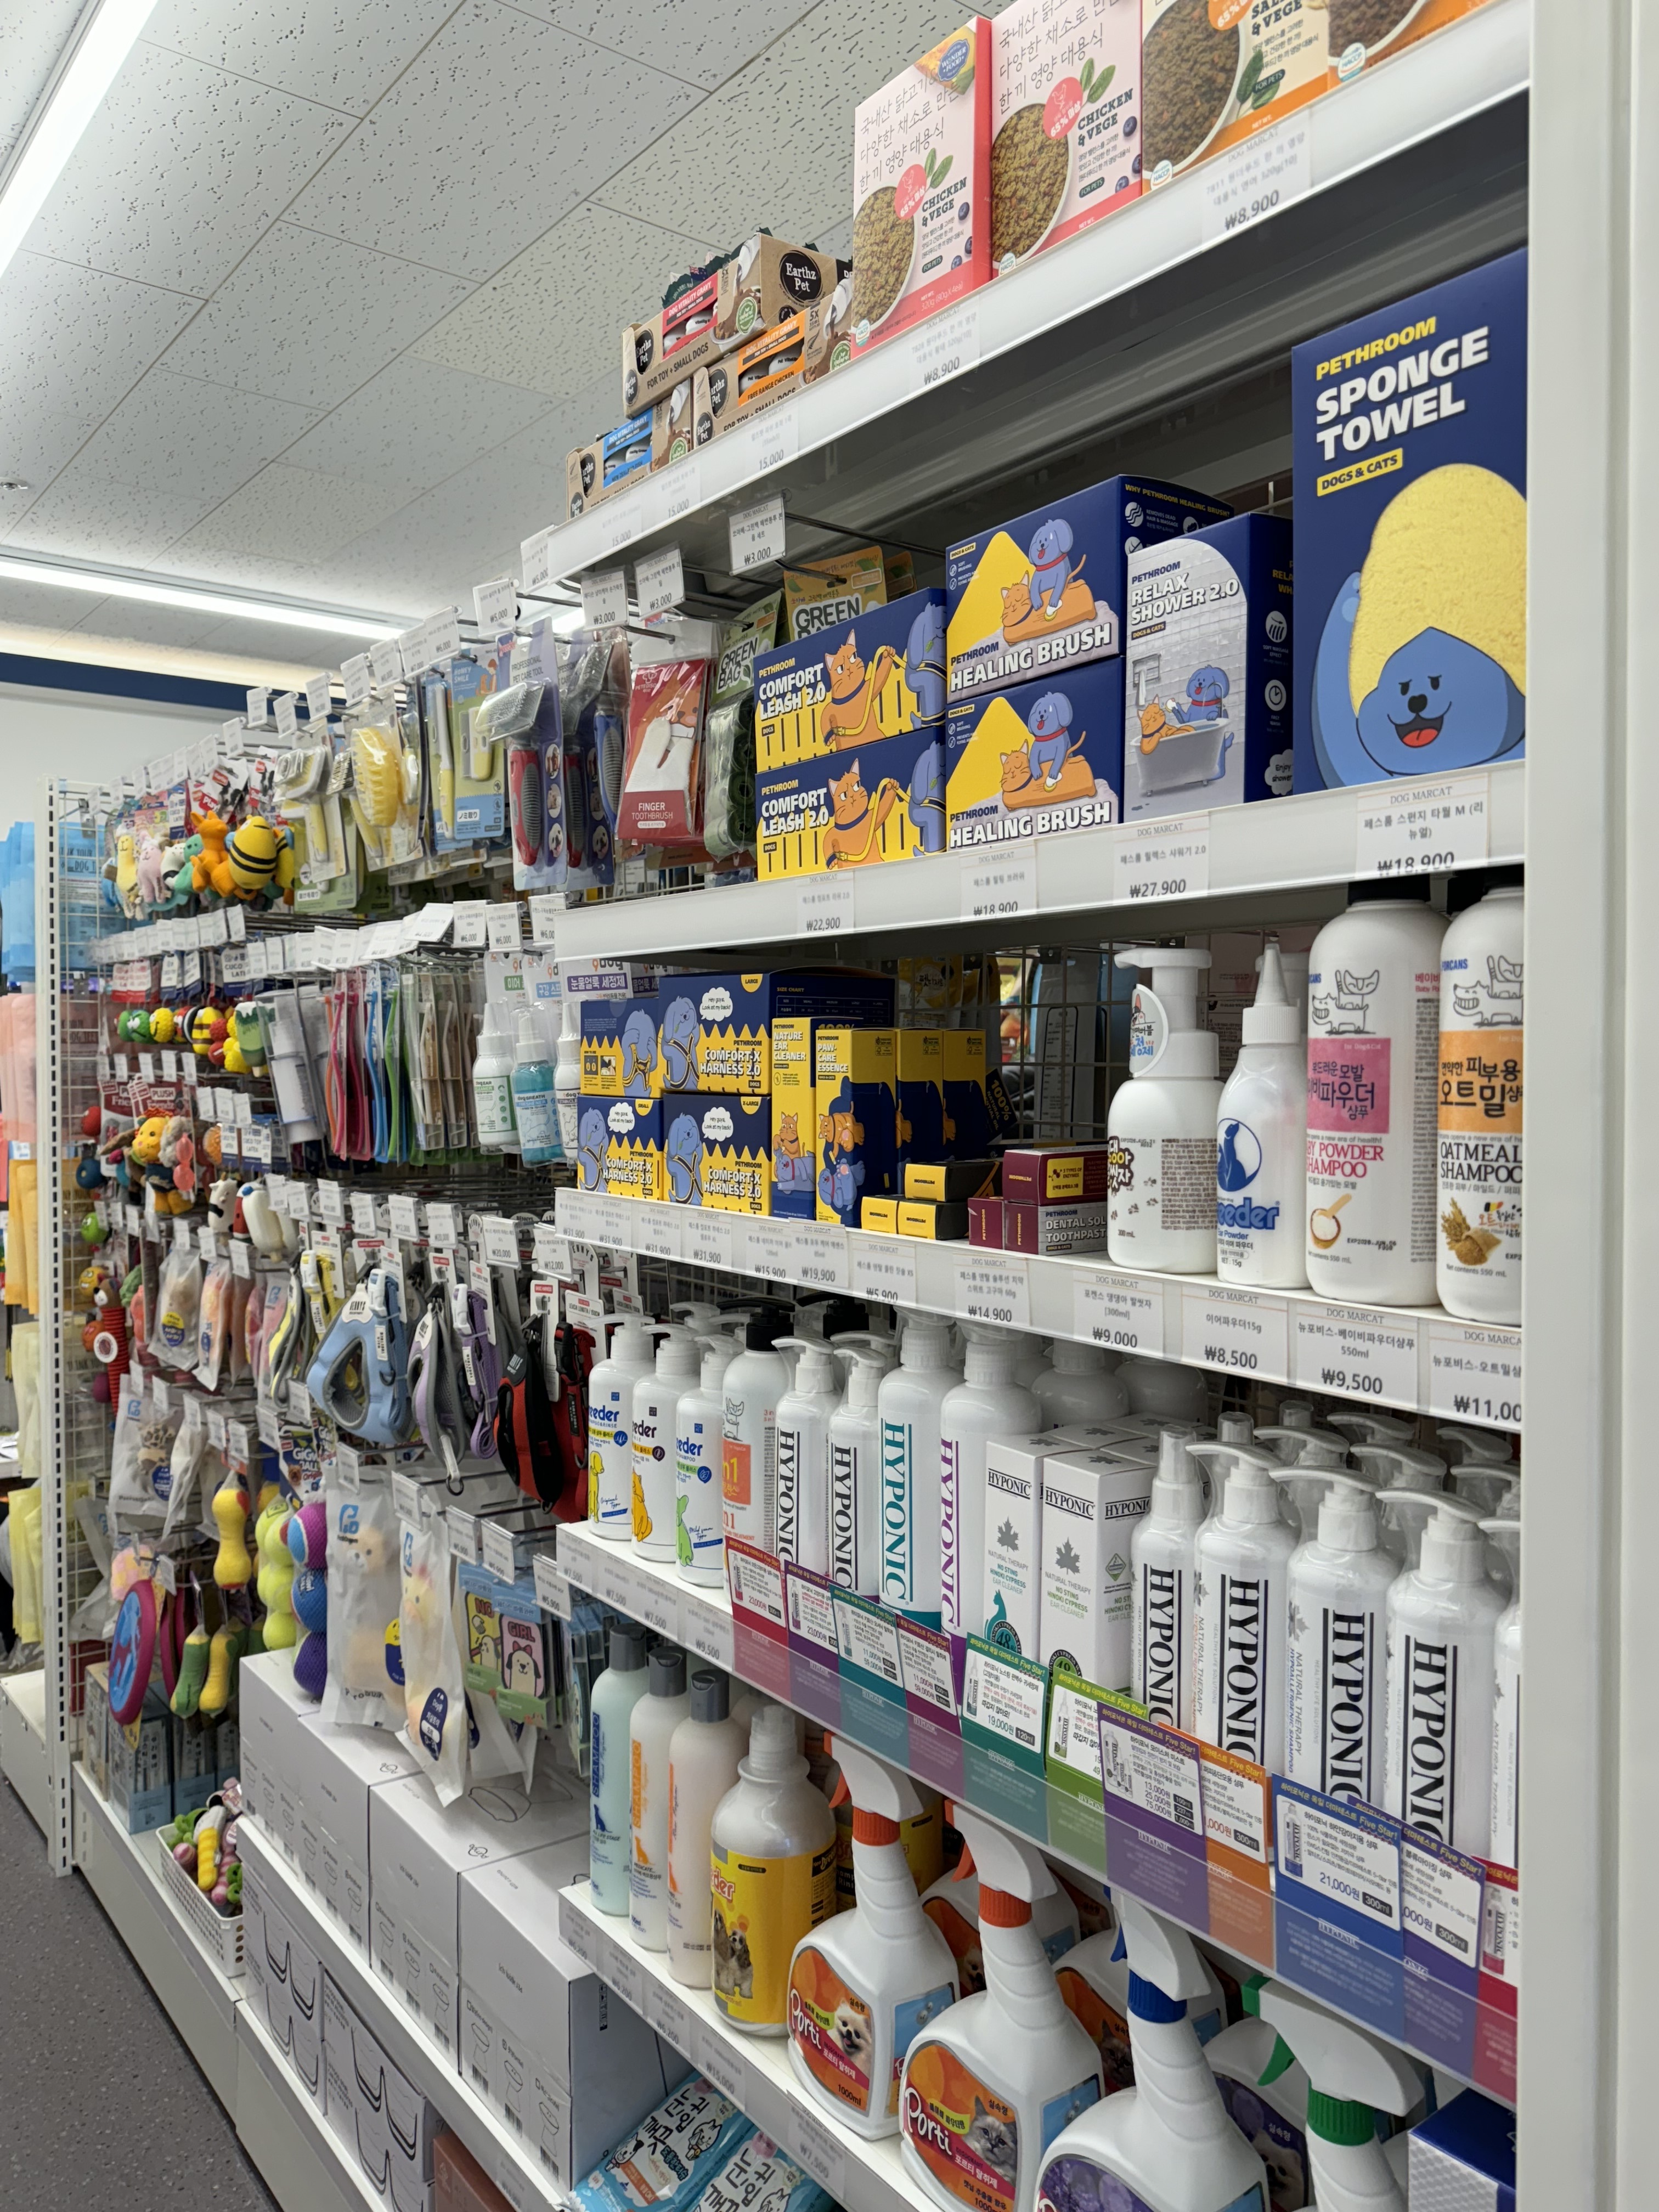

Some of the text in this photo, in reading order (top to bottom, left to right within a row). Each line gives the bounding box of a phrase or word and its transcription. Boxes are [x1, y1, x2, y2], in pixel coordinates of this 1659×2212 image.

[1000, 8, 1038, 48] 국내산
[1251, 0, 1302, 36] & VEGE
[1000, 6, 1088, 81] 다양한 채소로
[1000, 22, 1103, 115] 한 끼 영양 대용식
[1255, 72, 1283, 91] FOR PETS
[1077, 88, 1133, 131] CHICKEN
[1078, 113, 1118, 147] & VEGE
[885, 117, 944, 173] 영양 대용식
[922, 177, 967, 212] CHICKEN
[1081, 179, 1103, 196] FOR PETS
[922, 198, 955, 228] & VEGE
[1225, 189, 1279, 230] ₩8,900
[786, 265, 816, 280] Earthz
[923, 256, 941, 272] FOR PETS
[794, 279, 810, 292] Pet
[1317, 316, 1436, 381] PETHROOM
[923, 357, 960, 383] ₩8,900
[1317, 326, 1488, 425] SPONGE
[1317, 382, 1465, 461] TOWEL
[1322, 455, 1398, 490] DOGS & CATS
[744, 546, 771, 565] ₩3,000
[1131, 561, 1181, 584] PETHROOM
[1131, 572, 1189, 607] RELAX
[1131, 579, 1239, 626] SHOWER 2.0
[593, 612, 616, 625] ₩3,000
[795, 597, 862, 630] GREEN
[511, 654, 542, 673] PROFESSIONAL
[720, 636, 758, 675] GREEN
[950, 642, 999, 667] PETHROOM
[950, 623, 1111, 693] HEALING BRUSH
[513, 666, 544, 684] PET CARE TOOL
[758, 657, 795, 679] PETHROOM
[759, 663, 824, 701] COMFORT
[760, 681, 826, 721] LEASH 2.0
[761, 779, 799, 796] PETHROOM
[1272, 775, 1293, 783] shower
[761, 788, 827, 819] COMFORT
[1390, 786, 1453, 805] DOG MARCAT
[458, 811, 478, 820] ノミ取り
[631, 810, 673, 821] TOOTHBRUSH
[638, 802, 665, 811] FINGER
[950, 804, 998, 822] PETHROOM
[762, 807, 830, 838] LEASH 2.0
[949, 801, 1111, 849] HEALING BRUSH
[1137, 822, 1183, 837] DOG MARCAT
[1128, 878, 1187, 899] ₩27,900
[973, 900, 1018, 918] ₩18,900
[571, 975, 625, 990] 눈물얼룩 세정제
[774, 1031, 803, 1041] NATURE
[774, 1042, 788, 1051] EAR
[705, 1050, 761, 1063] COMFORT-X
[774, 1052, 806, 1061] CLEANER
[817, 1053, 837, 1063] CARE
[700, 1063, 761, 1076] HARNESS 2.0
[817, 1064, 849, 1073] ESSENCE
[1466, 1056, 1520, 1084] 피부용
[990, 1079, 1010, 1121] 100%
[1347, 1104, 1369, 1120] 샴푸
[1319, 1143, 1384, 1161] POWDER
[1440, 1141, 1522, 1163] OATMEAL
[607, 1157, 653, 1172] COMFORT-X
[603, 1170, 652, 1184] HARNESS 2.0
[708, 1168, 761, 1184] COMFORT-X
[704, 1181, 761, 1199] HARNESS 2.0
[1045, 1210, 1078, 1218] PETHROOM
[693, 1249, 721, 1264] ₩31,900
[972, 1258, 1006, 1268] DOG MARCAT
[802, 1267, 836, 1283] ₩19,900
[1096, 1275, 1138, 1289] DOG MARCAT
[1209, 1290, 1259, 1305] DOG MARCAT
[968, 1304, 1012, 1323] ₩14,900
[1206, 1313, 1262, 1334] 이어파우더15g
[1327, 1308, 1385, 1324] DOG MARCAT
[1092, 1327, 1138, 1348] ₩9,000
[1298, 1321, 1415, 1351] 뉴포비스-베이비파우더샴푸
[1205, 1345, 1257, 1369] ₩8,500
[1341, 1345, 1369, 1359] 550ml
[1321, 1368, 1383, 1395] ₩9,500
[988, 1471, 1031, 1497] HYPONIC
[884, 1419, 907, 1604] HYPONIC
[1045, 1489, 1094, 1517] HYPONIC
[833, 1446, 853, 1590] HYPONIC
[988, 1549, 1029, 1571] NATURAL THERAPY
[990, 1568, 1026, 1588] HINOKI CYPRESS
[1004, 1566, 1018, 1577] STING
[1045, 1571, 1091, 1595] NATURAL THERAPY
[1047, 1591, 1088, 1613] HINOKI CYPRESS
[1065, 1589, 1079, 1601] STING
[508, 1621, 536, 1643] GIRL
[591, 1713, 600, 1795] SHAMPOO
[632, 1741, 641, 1827] SHAMPOO
[1145, 1791, 1172, 1808] 25,000원
[1146, 1801, 1172, 1818] 75,000원
[1319, 1871, 1360, 1901] 21,000원
[1438, 1927, 1466, 1951] 300ml
[789, 1988, 822, 2050] Porti
[822, 2047, 856, 2080] 포르티 탈취제
[837, 2083, 862, 2107] 1000ml
[988, 2098, 1009, 2116] 실속형
[905, 2087, 952, 2156] Porti
[1267, 2122, 1292, 2142] 실속형
[954, 2153, 997, 2189] 포르티 탈취제
